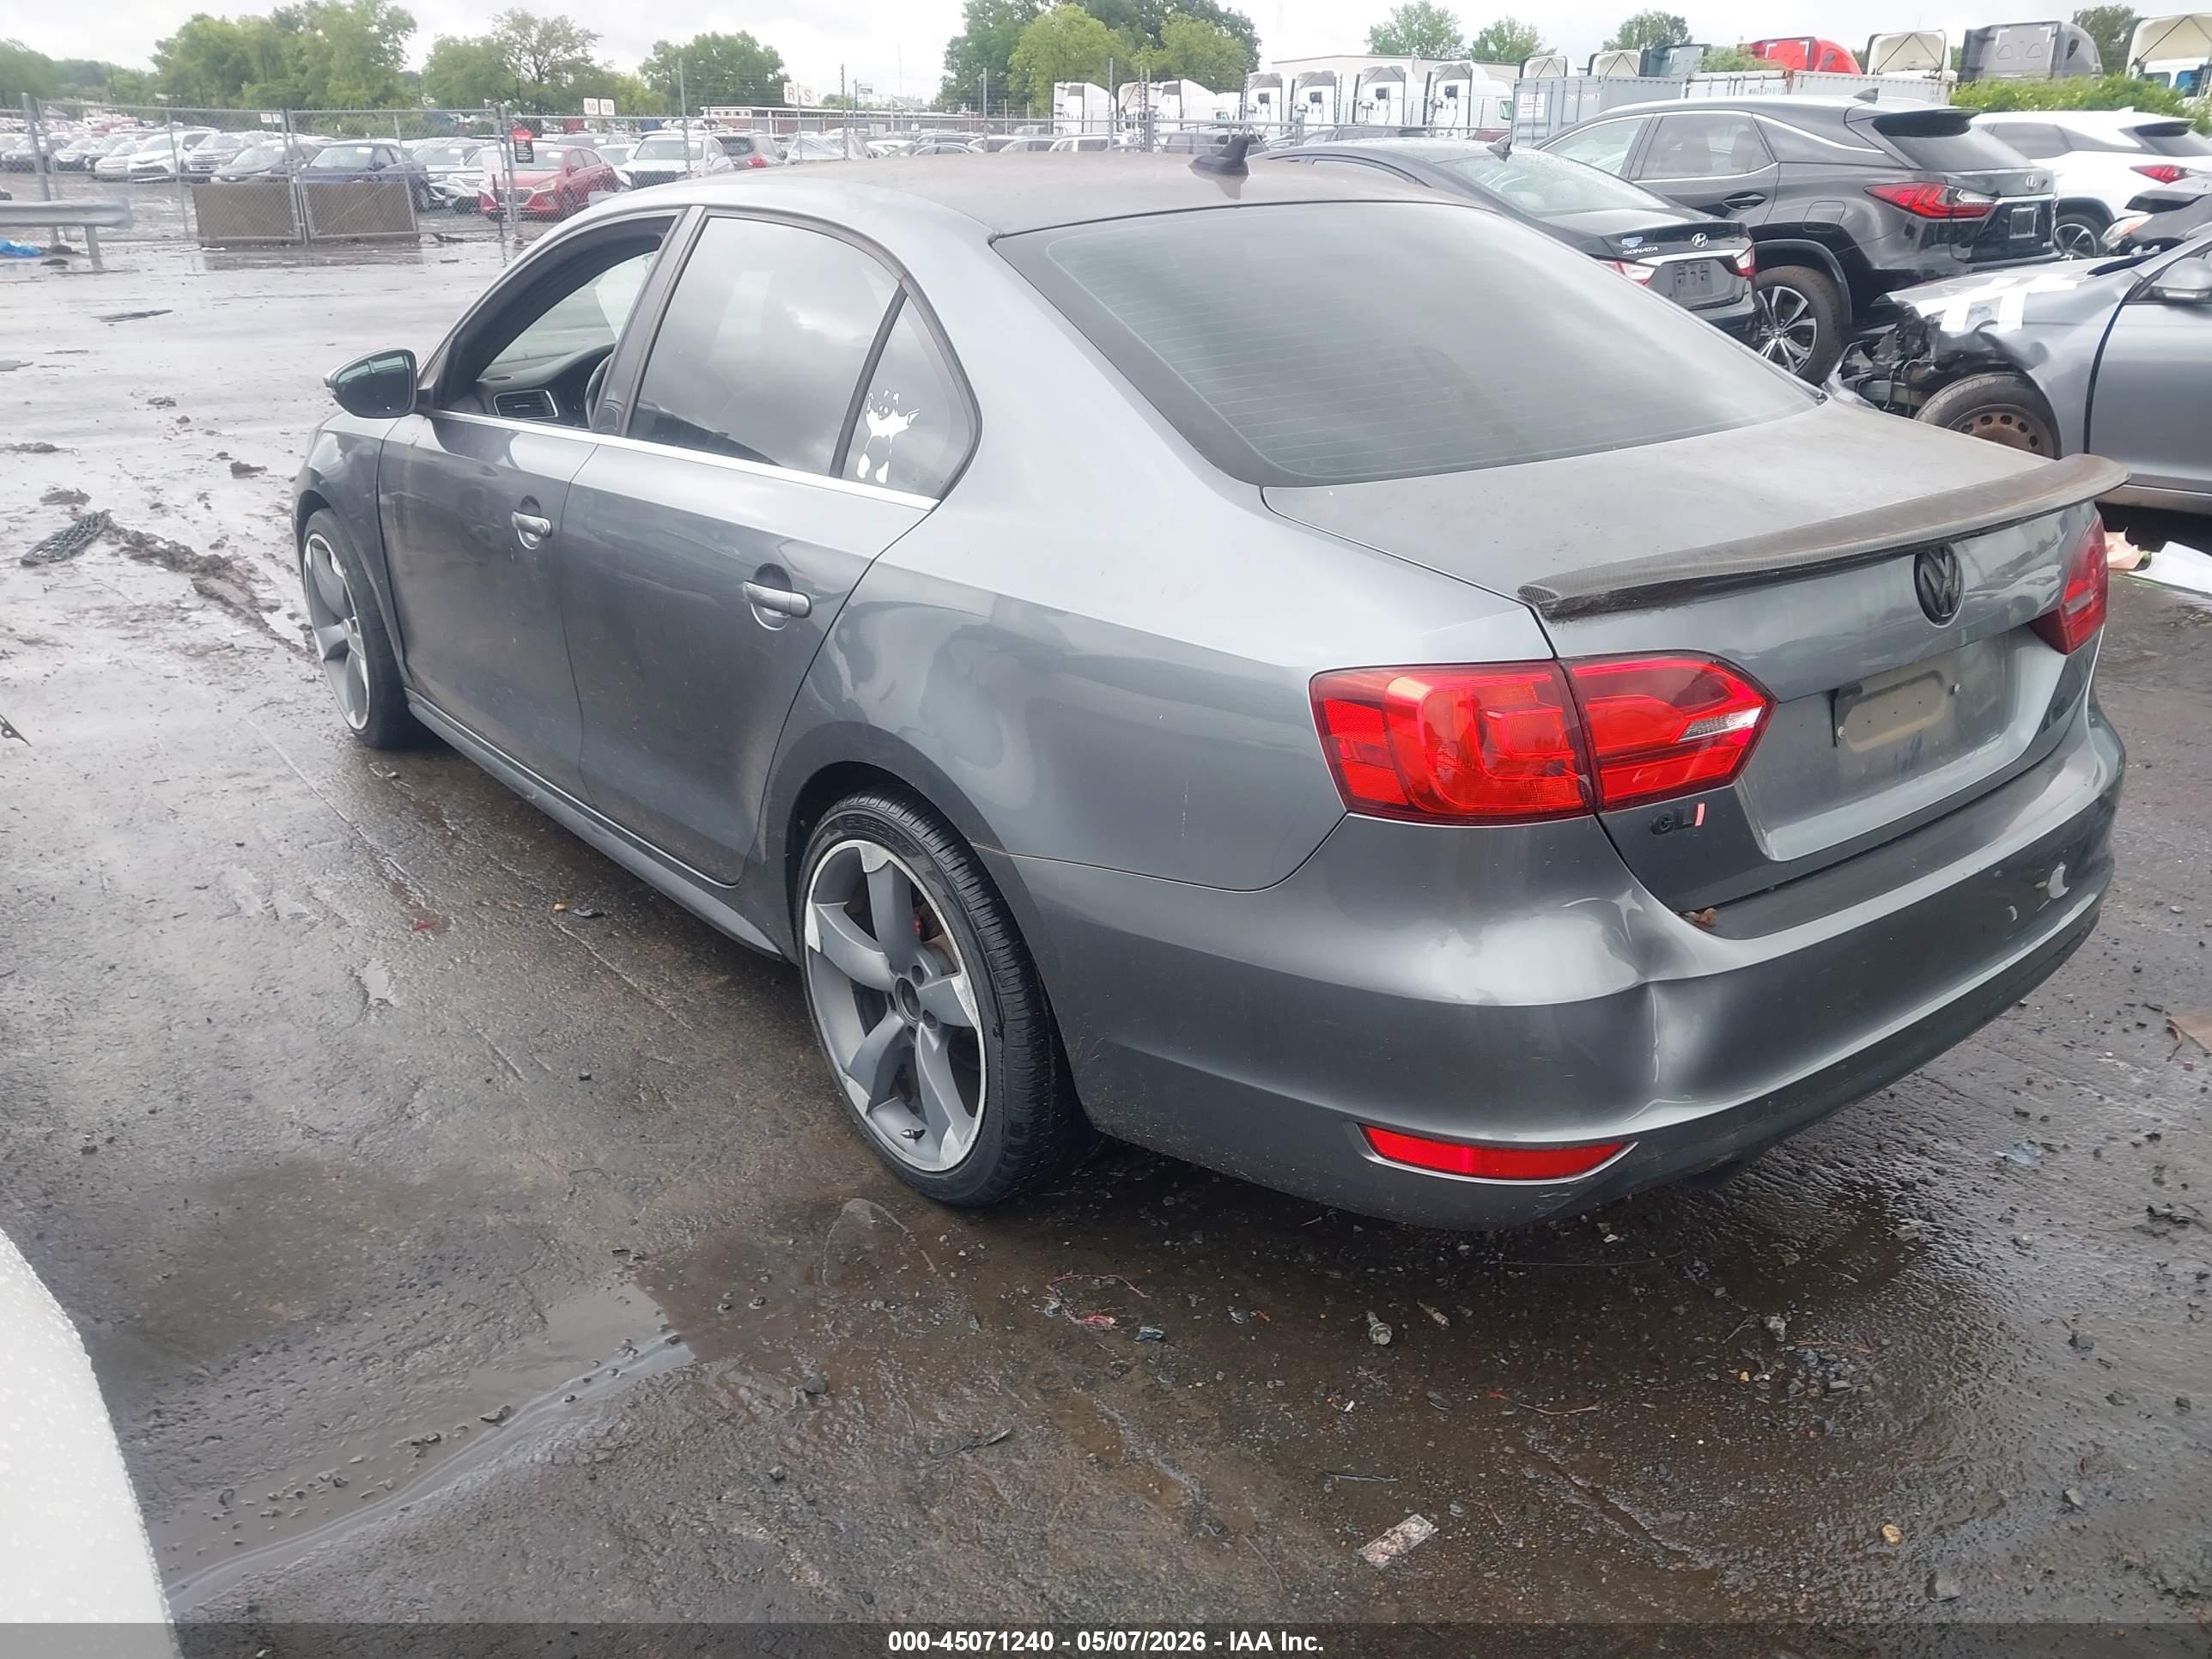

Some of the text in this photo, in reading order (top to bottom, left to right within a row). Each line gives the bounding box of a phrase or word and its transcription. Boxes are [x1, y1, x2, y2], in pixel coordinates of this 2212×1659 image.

[787, 86, 795, 100] R
[804, 88, 811, 102] S
[586, 102, 596, 111] 10
[603, 103, 612, 112] 10
[1622, 246, 1659, 256] SONATA
[1651, 802, 1706, 836] GLI
